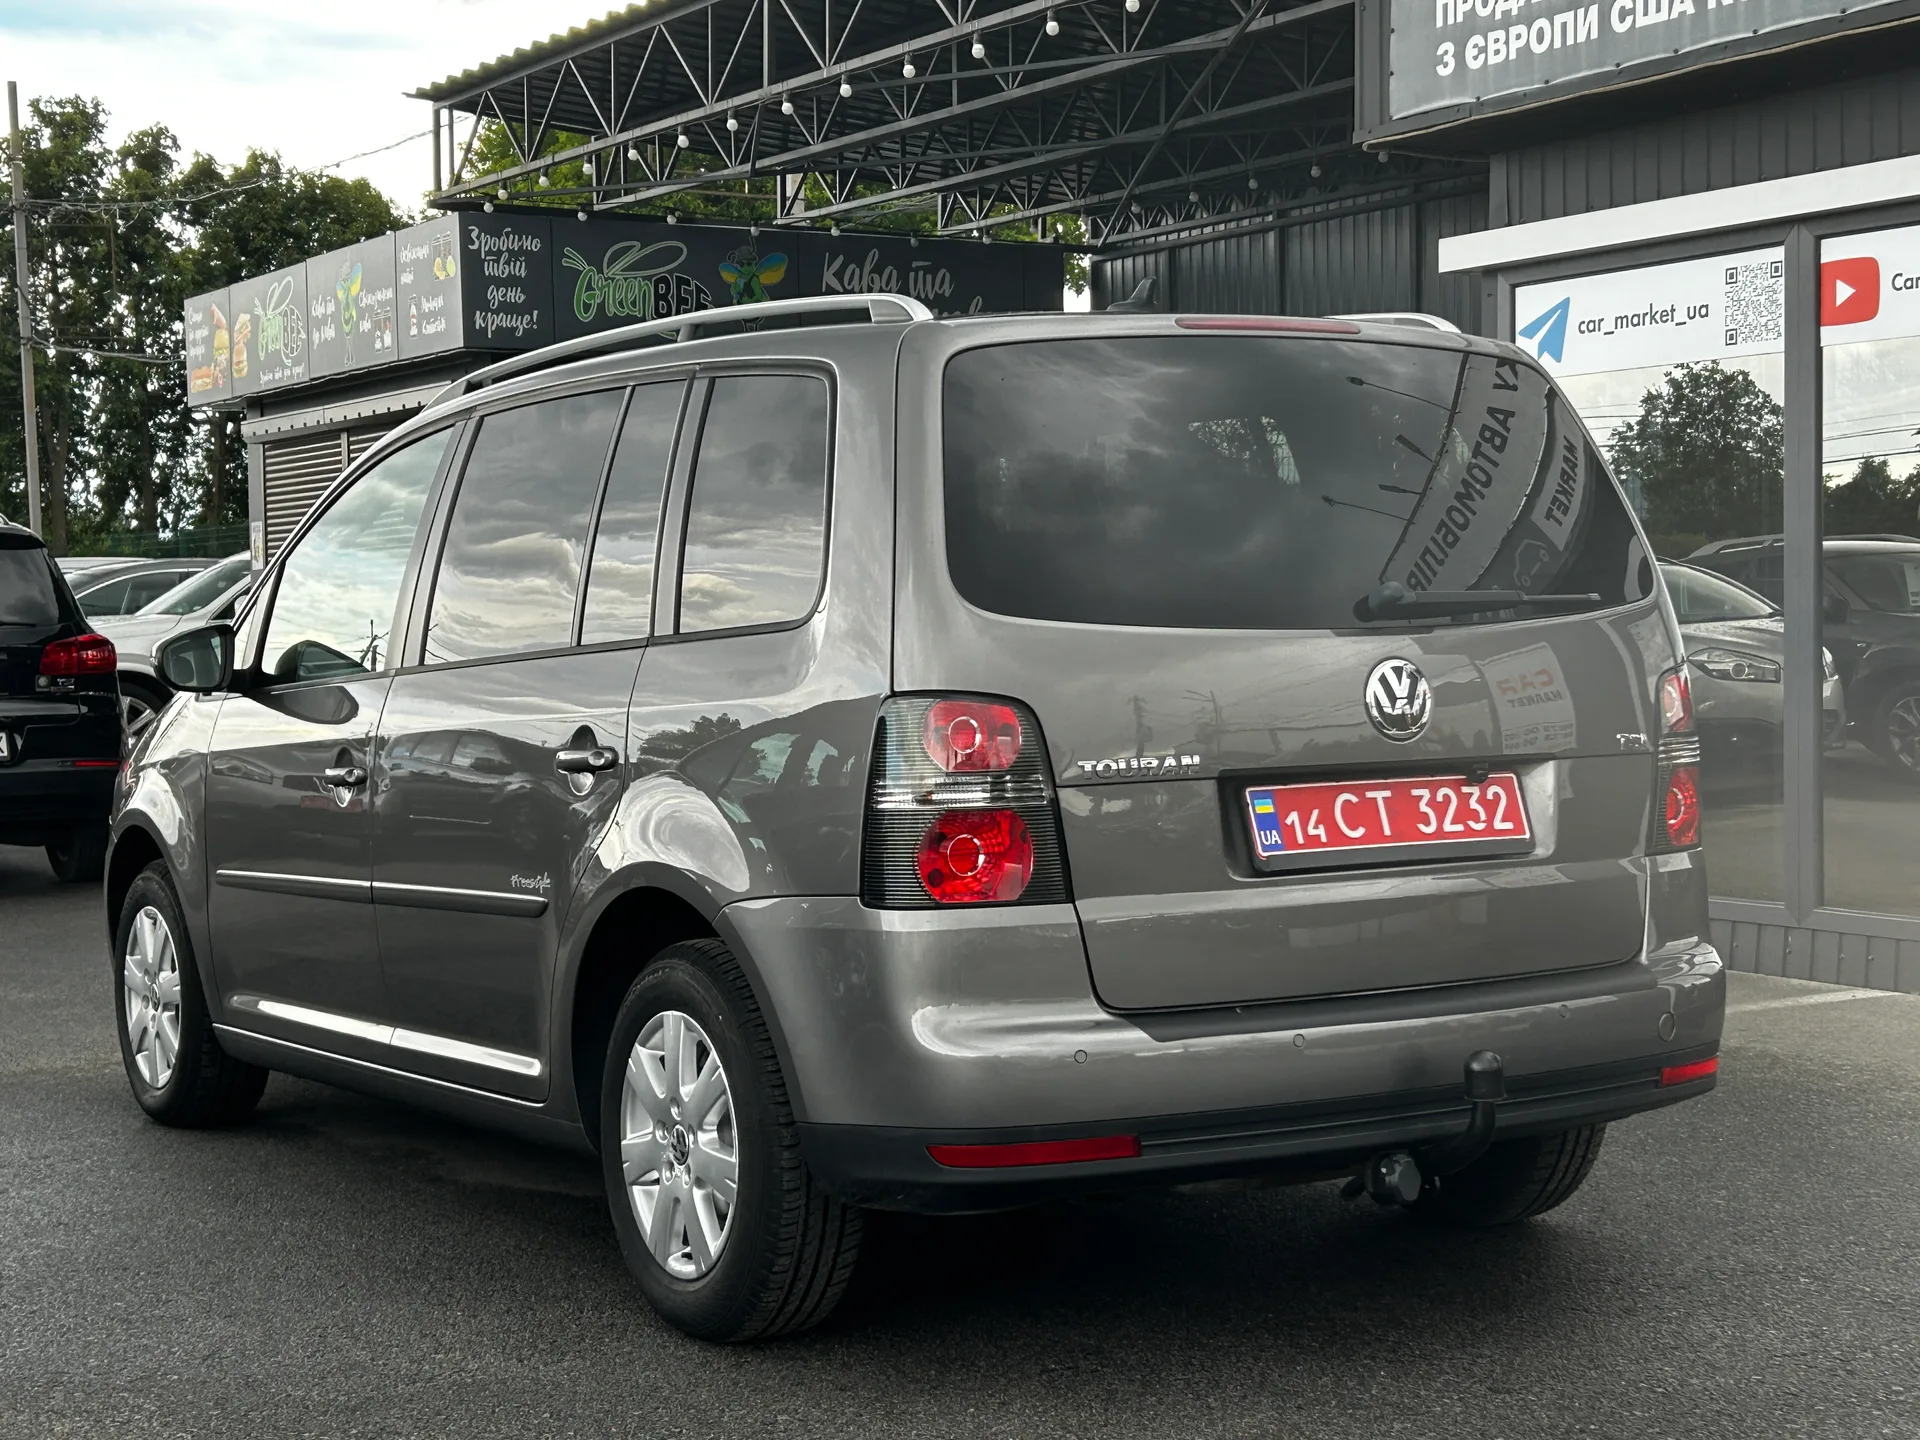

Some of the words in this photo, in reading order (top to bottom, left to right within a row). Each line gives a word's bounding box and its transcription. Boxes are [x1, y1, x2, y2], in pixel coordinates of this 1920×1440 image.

[1436, 41, 1455, 76] З
[1465, 4, 1599, 70] ЄВРОПИ
[468, 226, 541, 259] Зробимо
[484, 252, 528, 278] твій
[822, 248, 902, 294] Кава
[909, 260, 955, 300] та
[487, 285, 526, 309] день
[474, 310, 539, 338] краще!
[1578, 303, 1710, 336] car_market_ua
[1078, 754, 1200, 779] TOURAN
[1411, 785, 1514, 834] 3232
[1261, 829, 1281, 845] UA
